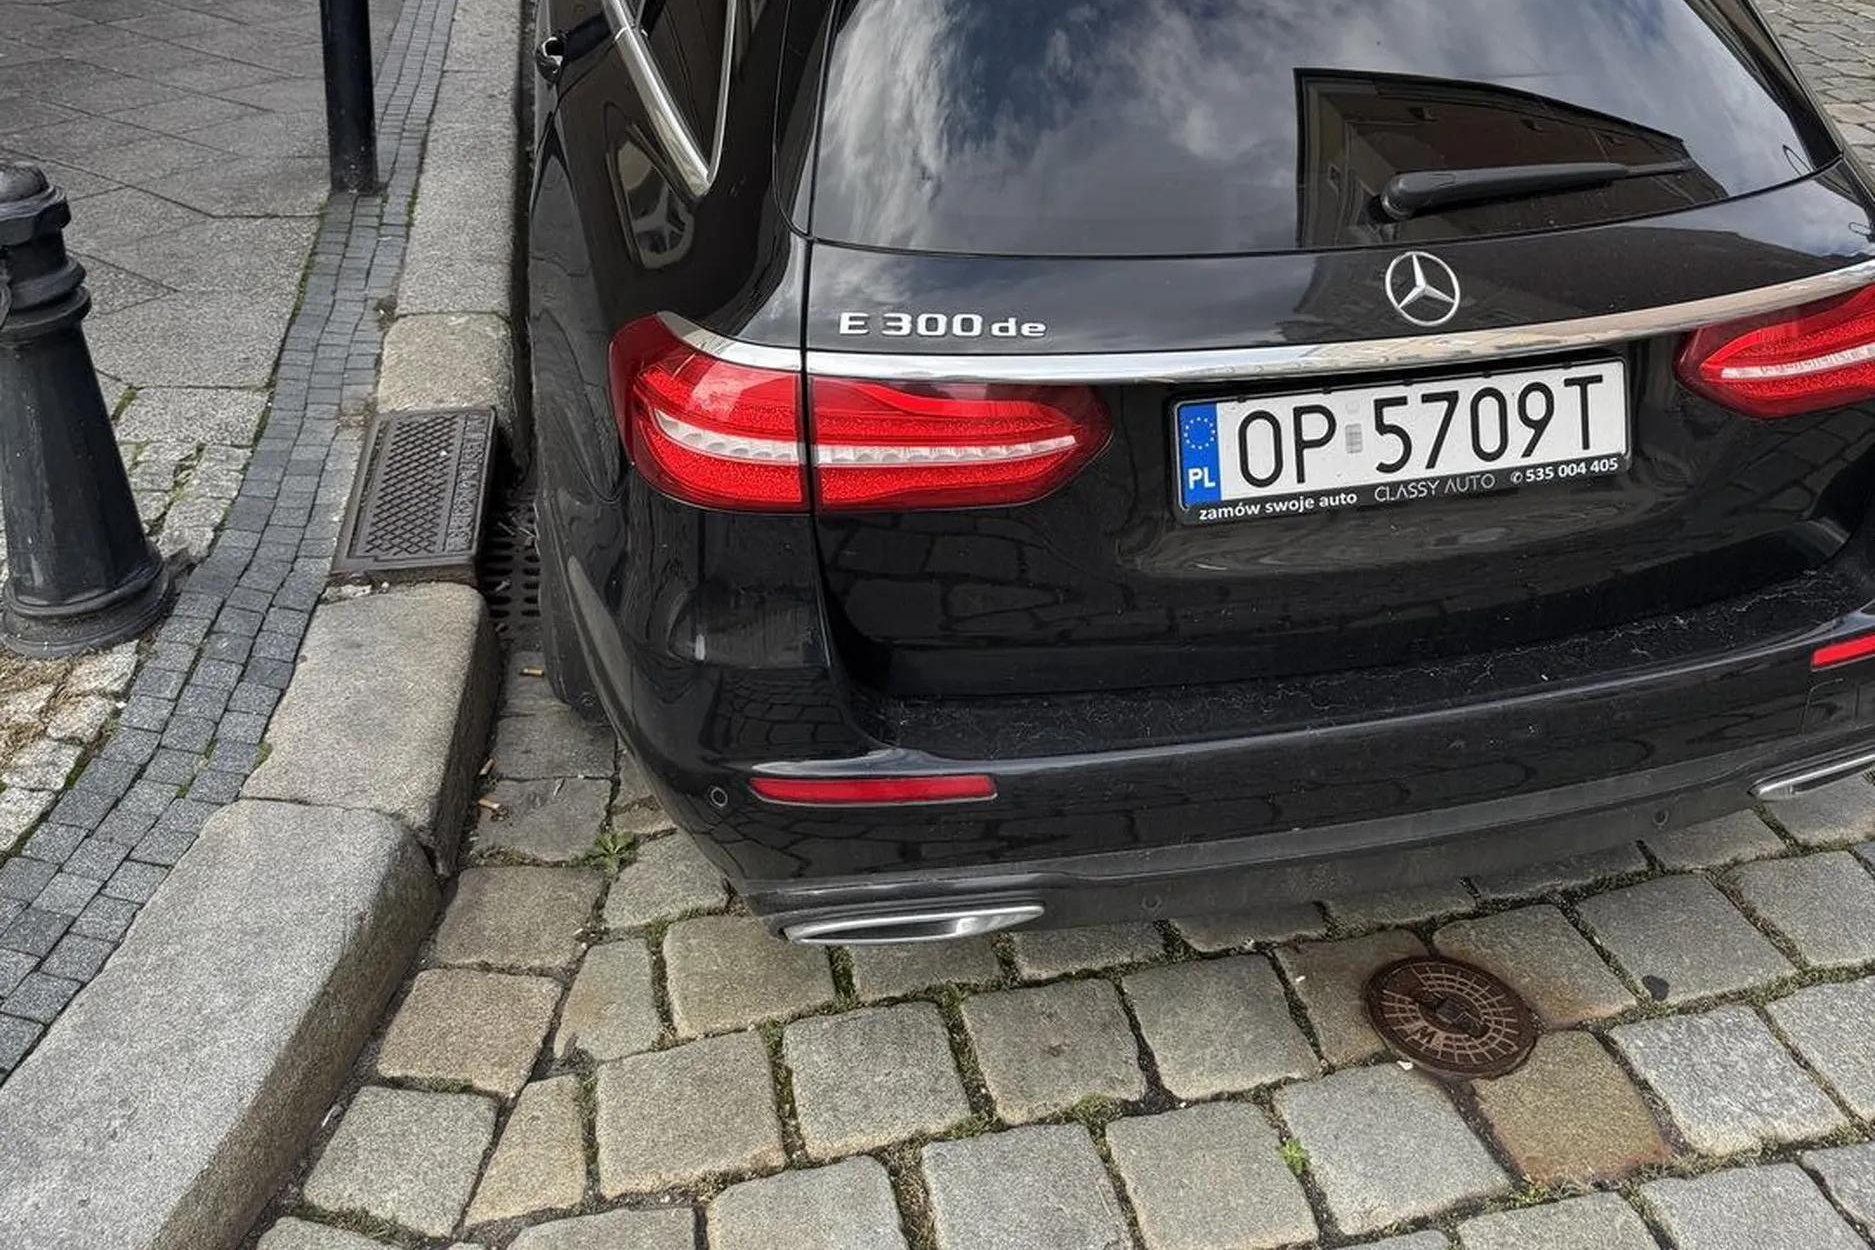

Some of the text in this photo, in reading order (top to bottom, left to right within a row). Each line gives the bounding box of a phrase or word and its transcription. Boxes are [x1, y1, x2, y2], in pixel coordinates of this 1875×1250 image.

[838, 312, 1047, 338] E 300 de
[1238, 374, 1604, 488] OP 5709T
[1187, 466, 1217, 490] PL
[1524, 456, 1620, 484] 535 004 405
[1373, 473, 1497, 503] CLASSY AUTO
[1199, 492, 1359, 521] zamów swoje auto
